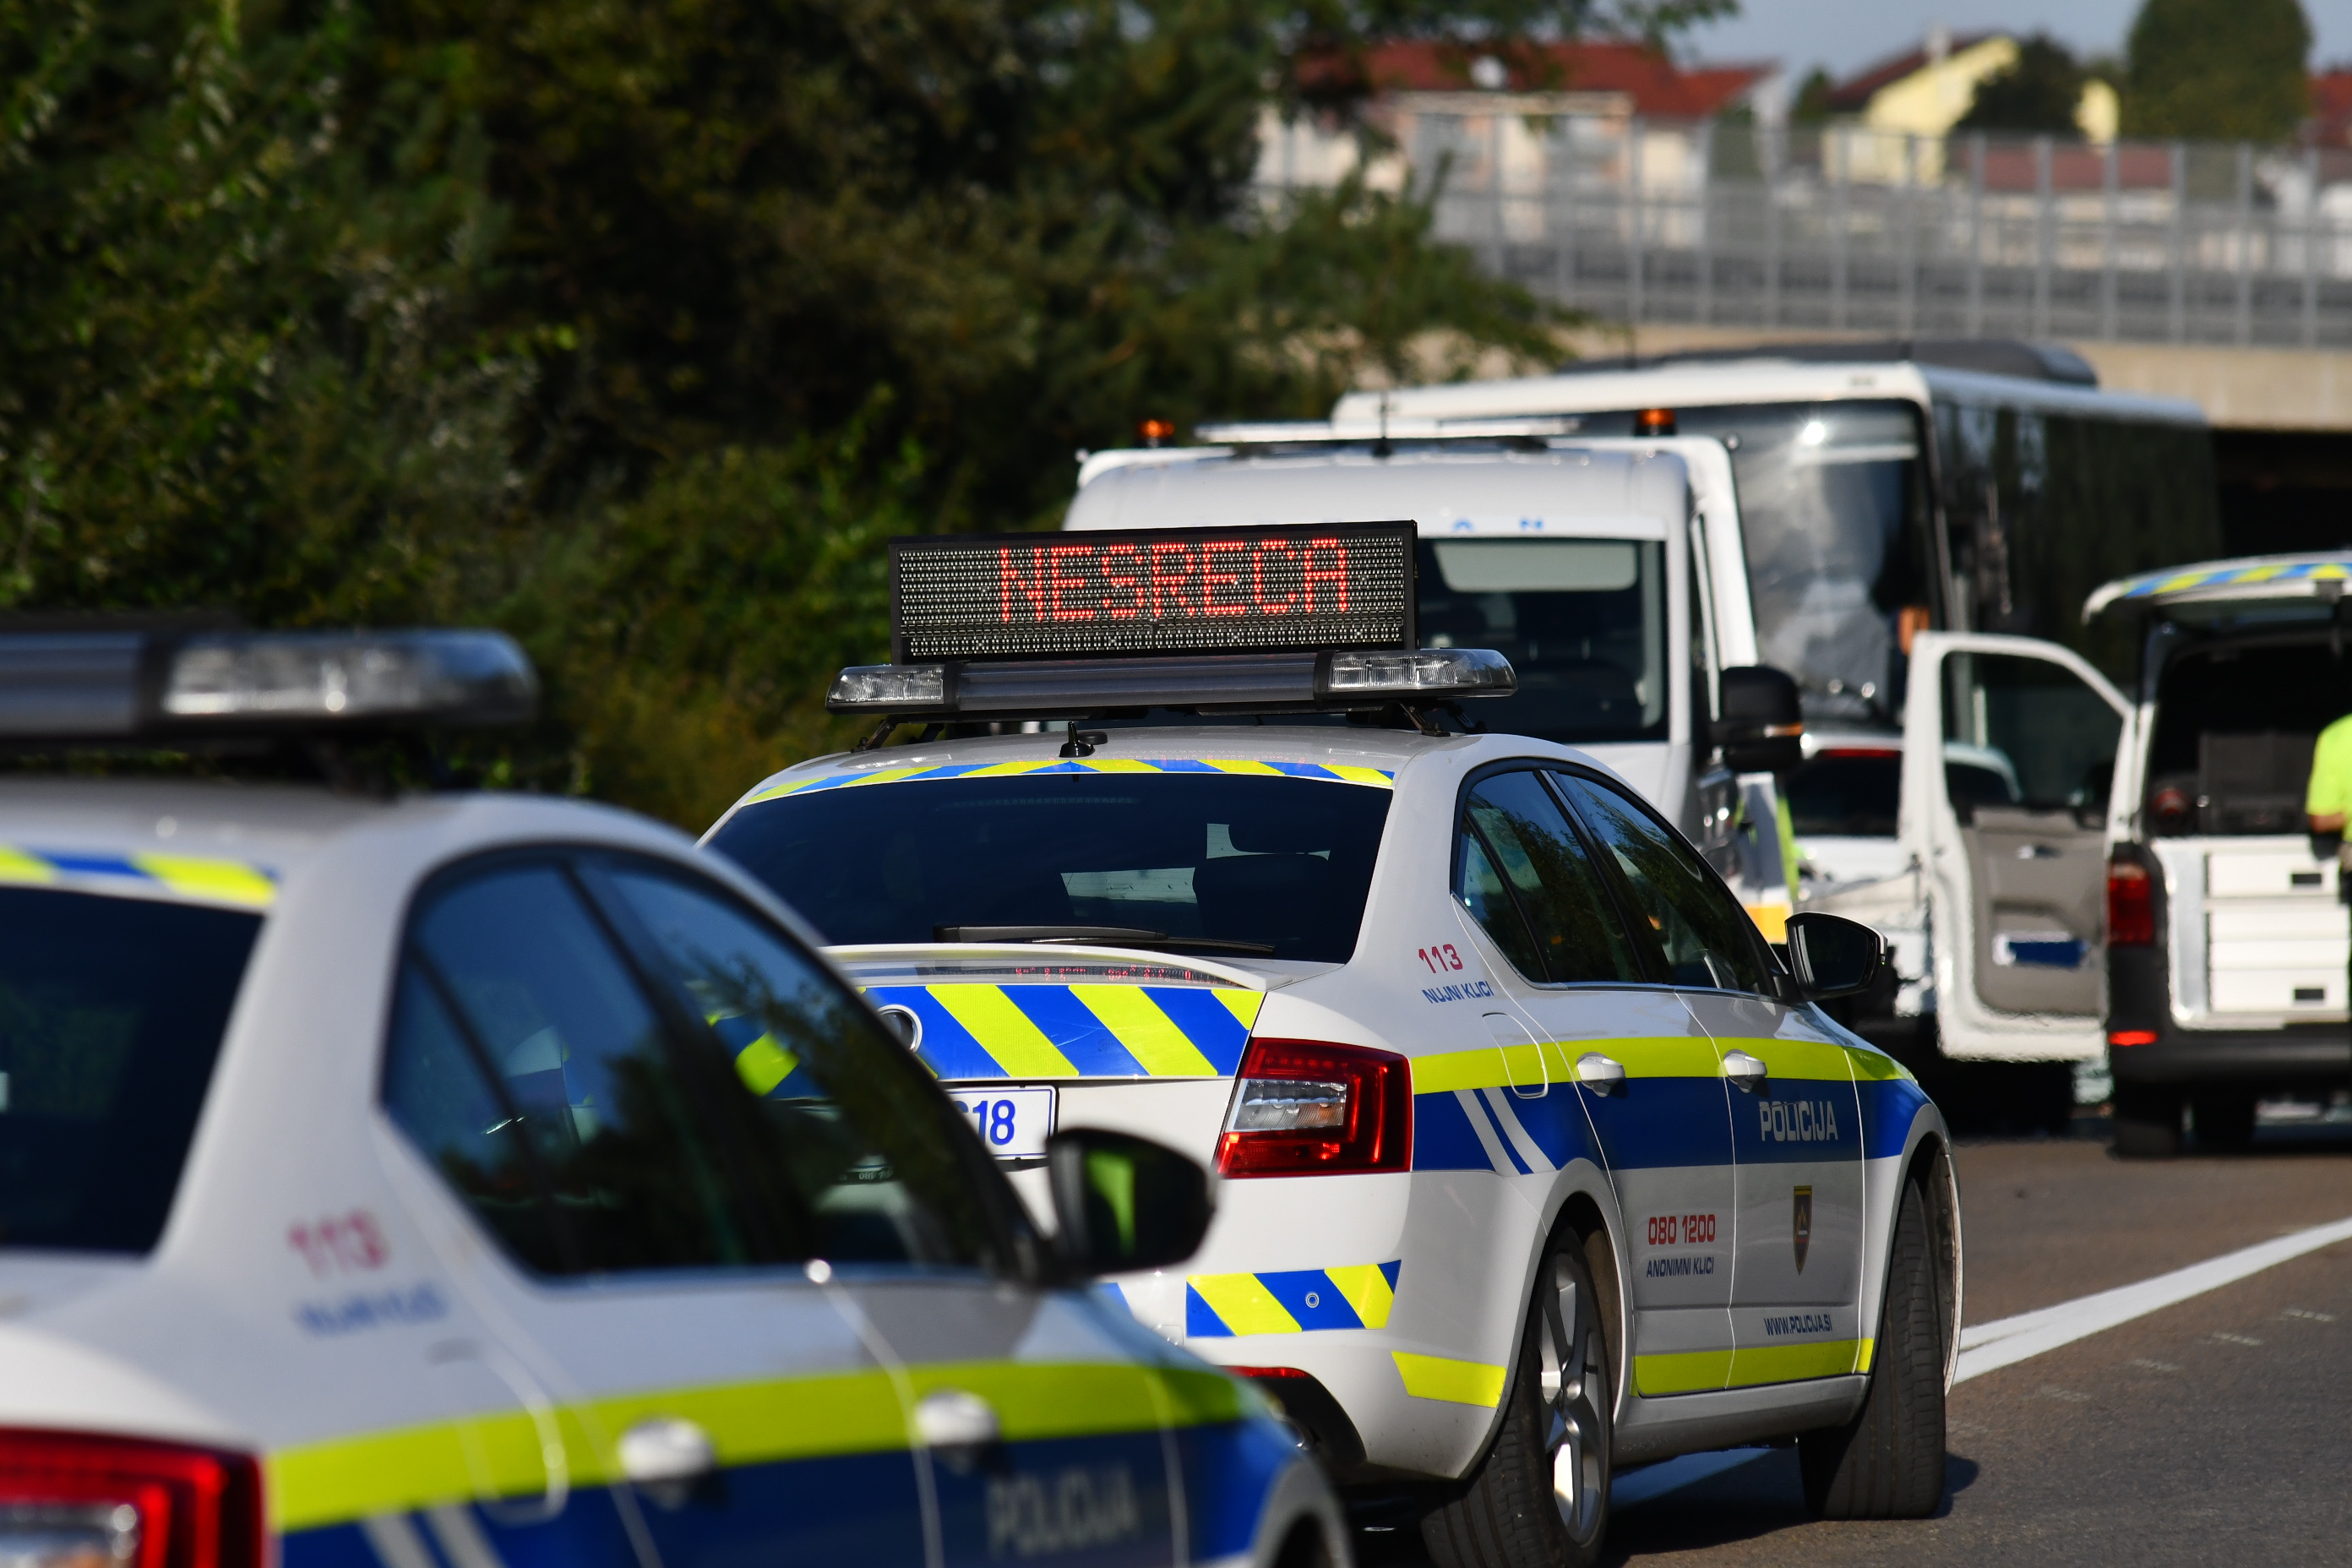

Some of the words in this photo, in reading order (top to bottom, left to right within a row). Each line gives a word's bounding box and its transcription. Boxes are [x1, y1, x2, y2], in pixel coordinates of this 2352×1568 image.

[1000, 538, 1348, 623] NESRECA
[1418, 944, 1463, 973] 113
[1422, 985, 1465, 1004] NUJNI
[1461, 981, 1494, 999] KLICI
[1759, 1101, 1839, 1141] POLICIJA
[1648, 1217, 1677, 1245] 080
[1682, 1214, 1716, 1244] 1200
[1647, 1258, 1691, 1277] ANONIMNI
[1693, 1256, 1715, 1275] KLICI
[1764, 1315, 1833, 1336] WWW.POLICIJA.SI
